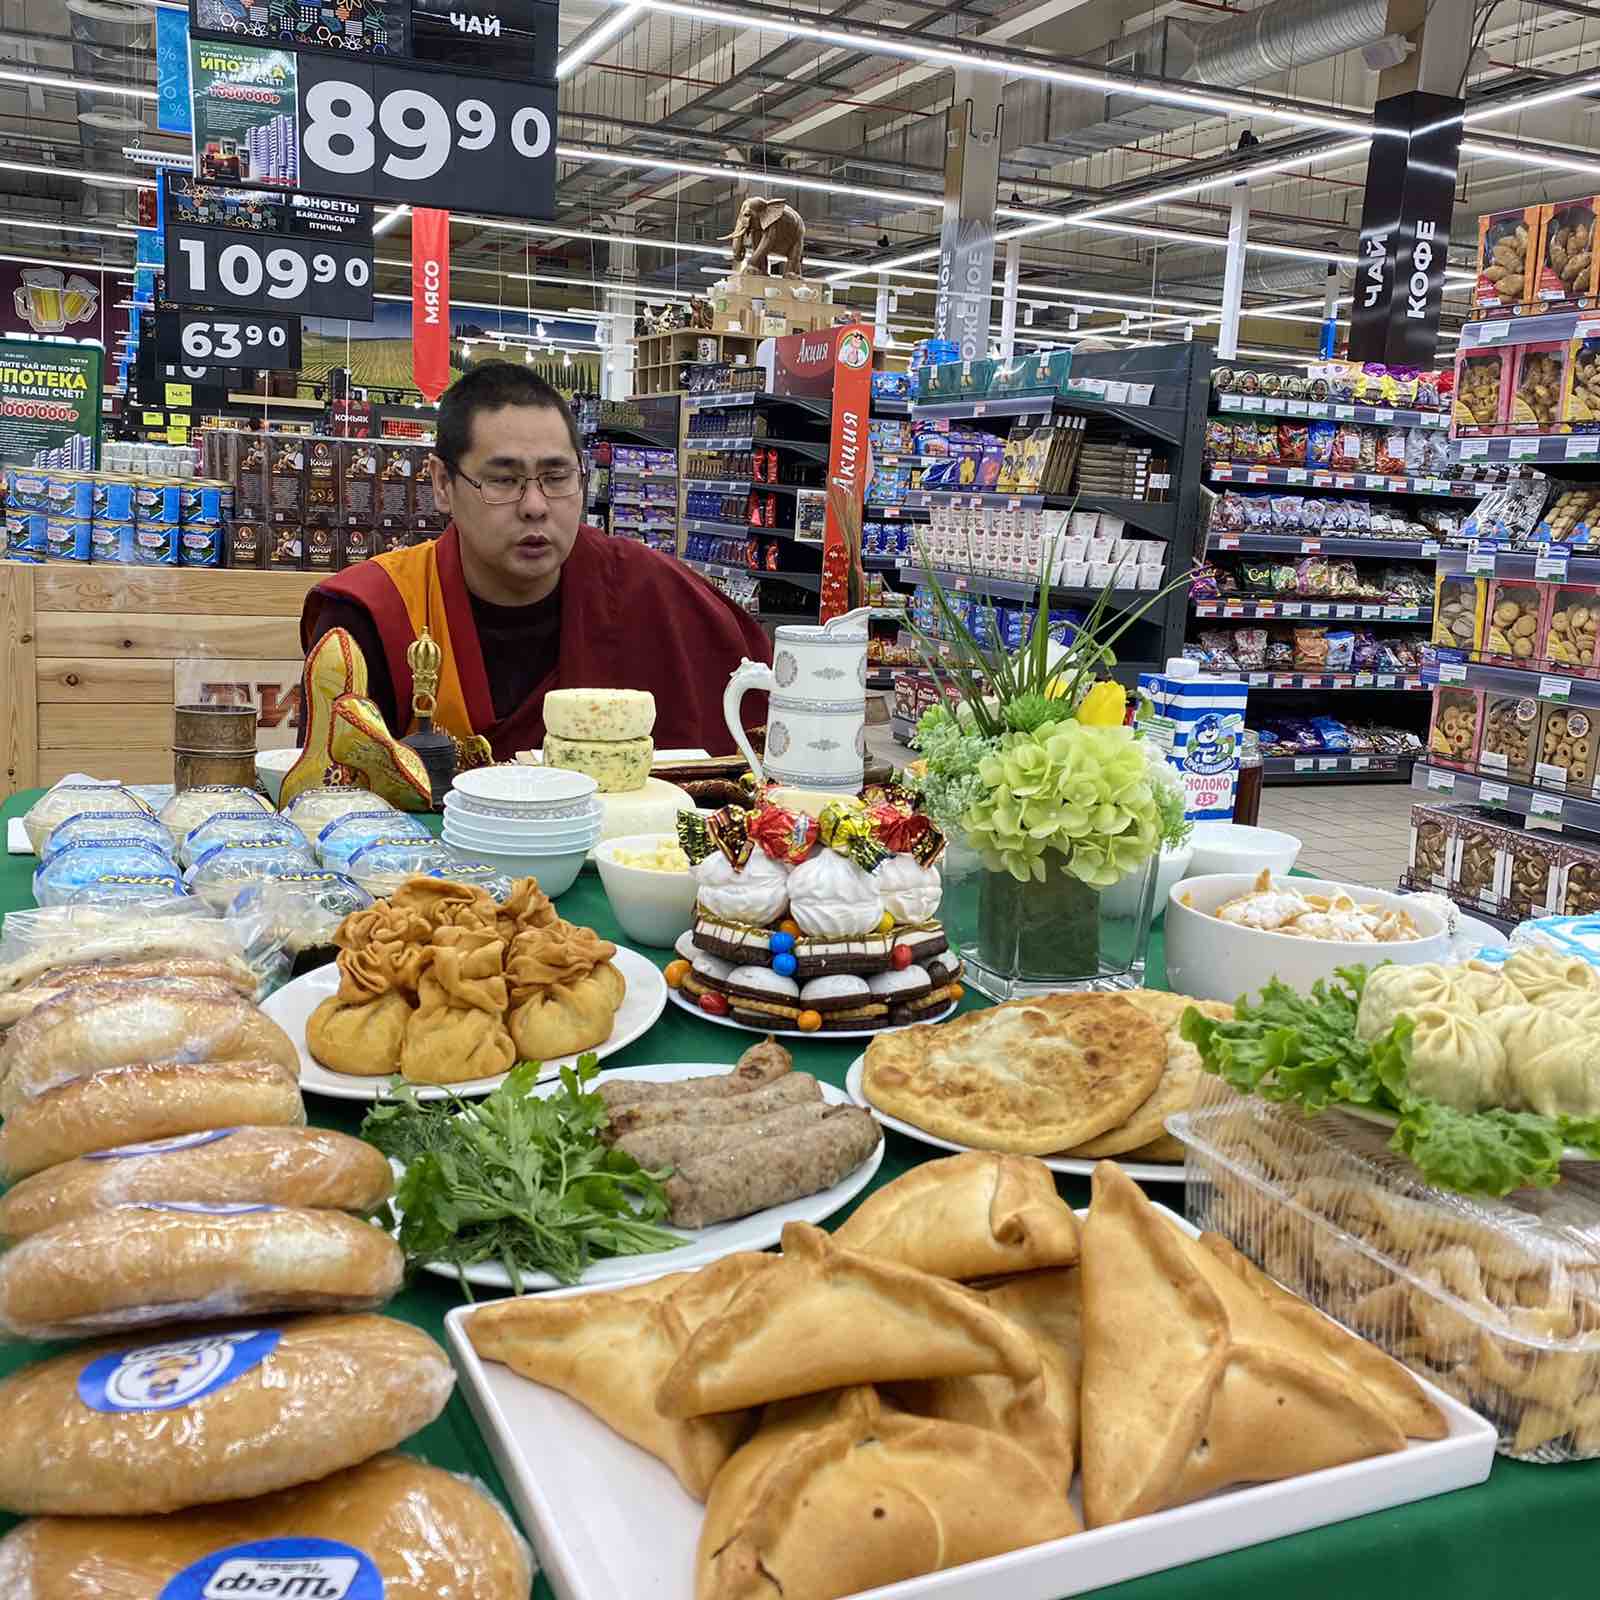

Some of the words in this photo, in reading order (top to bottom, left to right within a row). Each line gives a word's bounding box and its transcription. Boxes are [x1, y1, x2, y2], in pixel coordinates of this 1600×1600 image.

[450, 12, 500, 37] ЧАЙ
[303, 80, 452, 180] 89
[455, 98, 552, 158] 90
[293, 195, 361, 215] КОНФЕТЫ
[296, 210, 356, 225] БАЙКАЛЬСКАЯ
[309, 222, 343, 233] ПТИЧКА
[180, 239, 307, 299] 109
[312, 253, 369, 287] 90
[1363, 233, 1389, 308] ЧАЙ
[1406, 220, 1436, 319] КОФЕ
[424, 260, 440, 324] МЯСО
[182, 322, 242, 358] 63
[245, 325, 286, 347] 90
[796, 338, 829, 364] Акция
[22, 362, 39, 370] ЧАЙ
[41, 364, 57, 372] ИЛИ
[58, 365, 81, 373] КОФЕ
[2, 384, 18, 394] ЗА
[21, 386, 49, 396] НАШ
[830, 412, 859, 495] Акция
[1185, 777, 1230, 791] МОЛОКО
